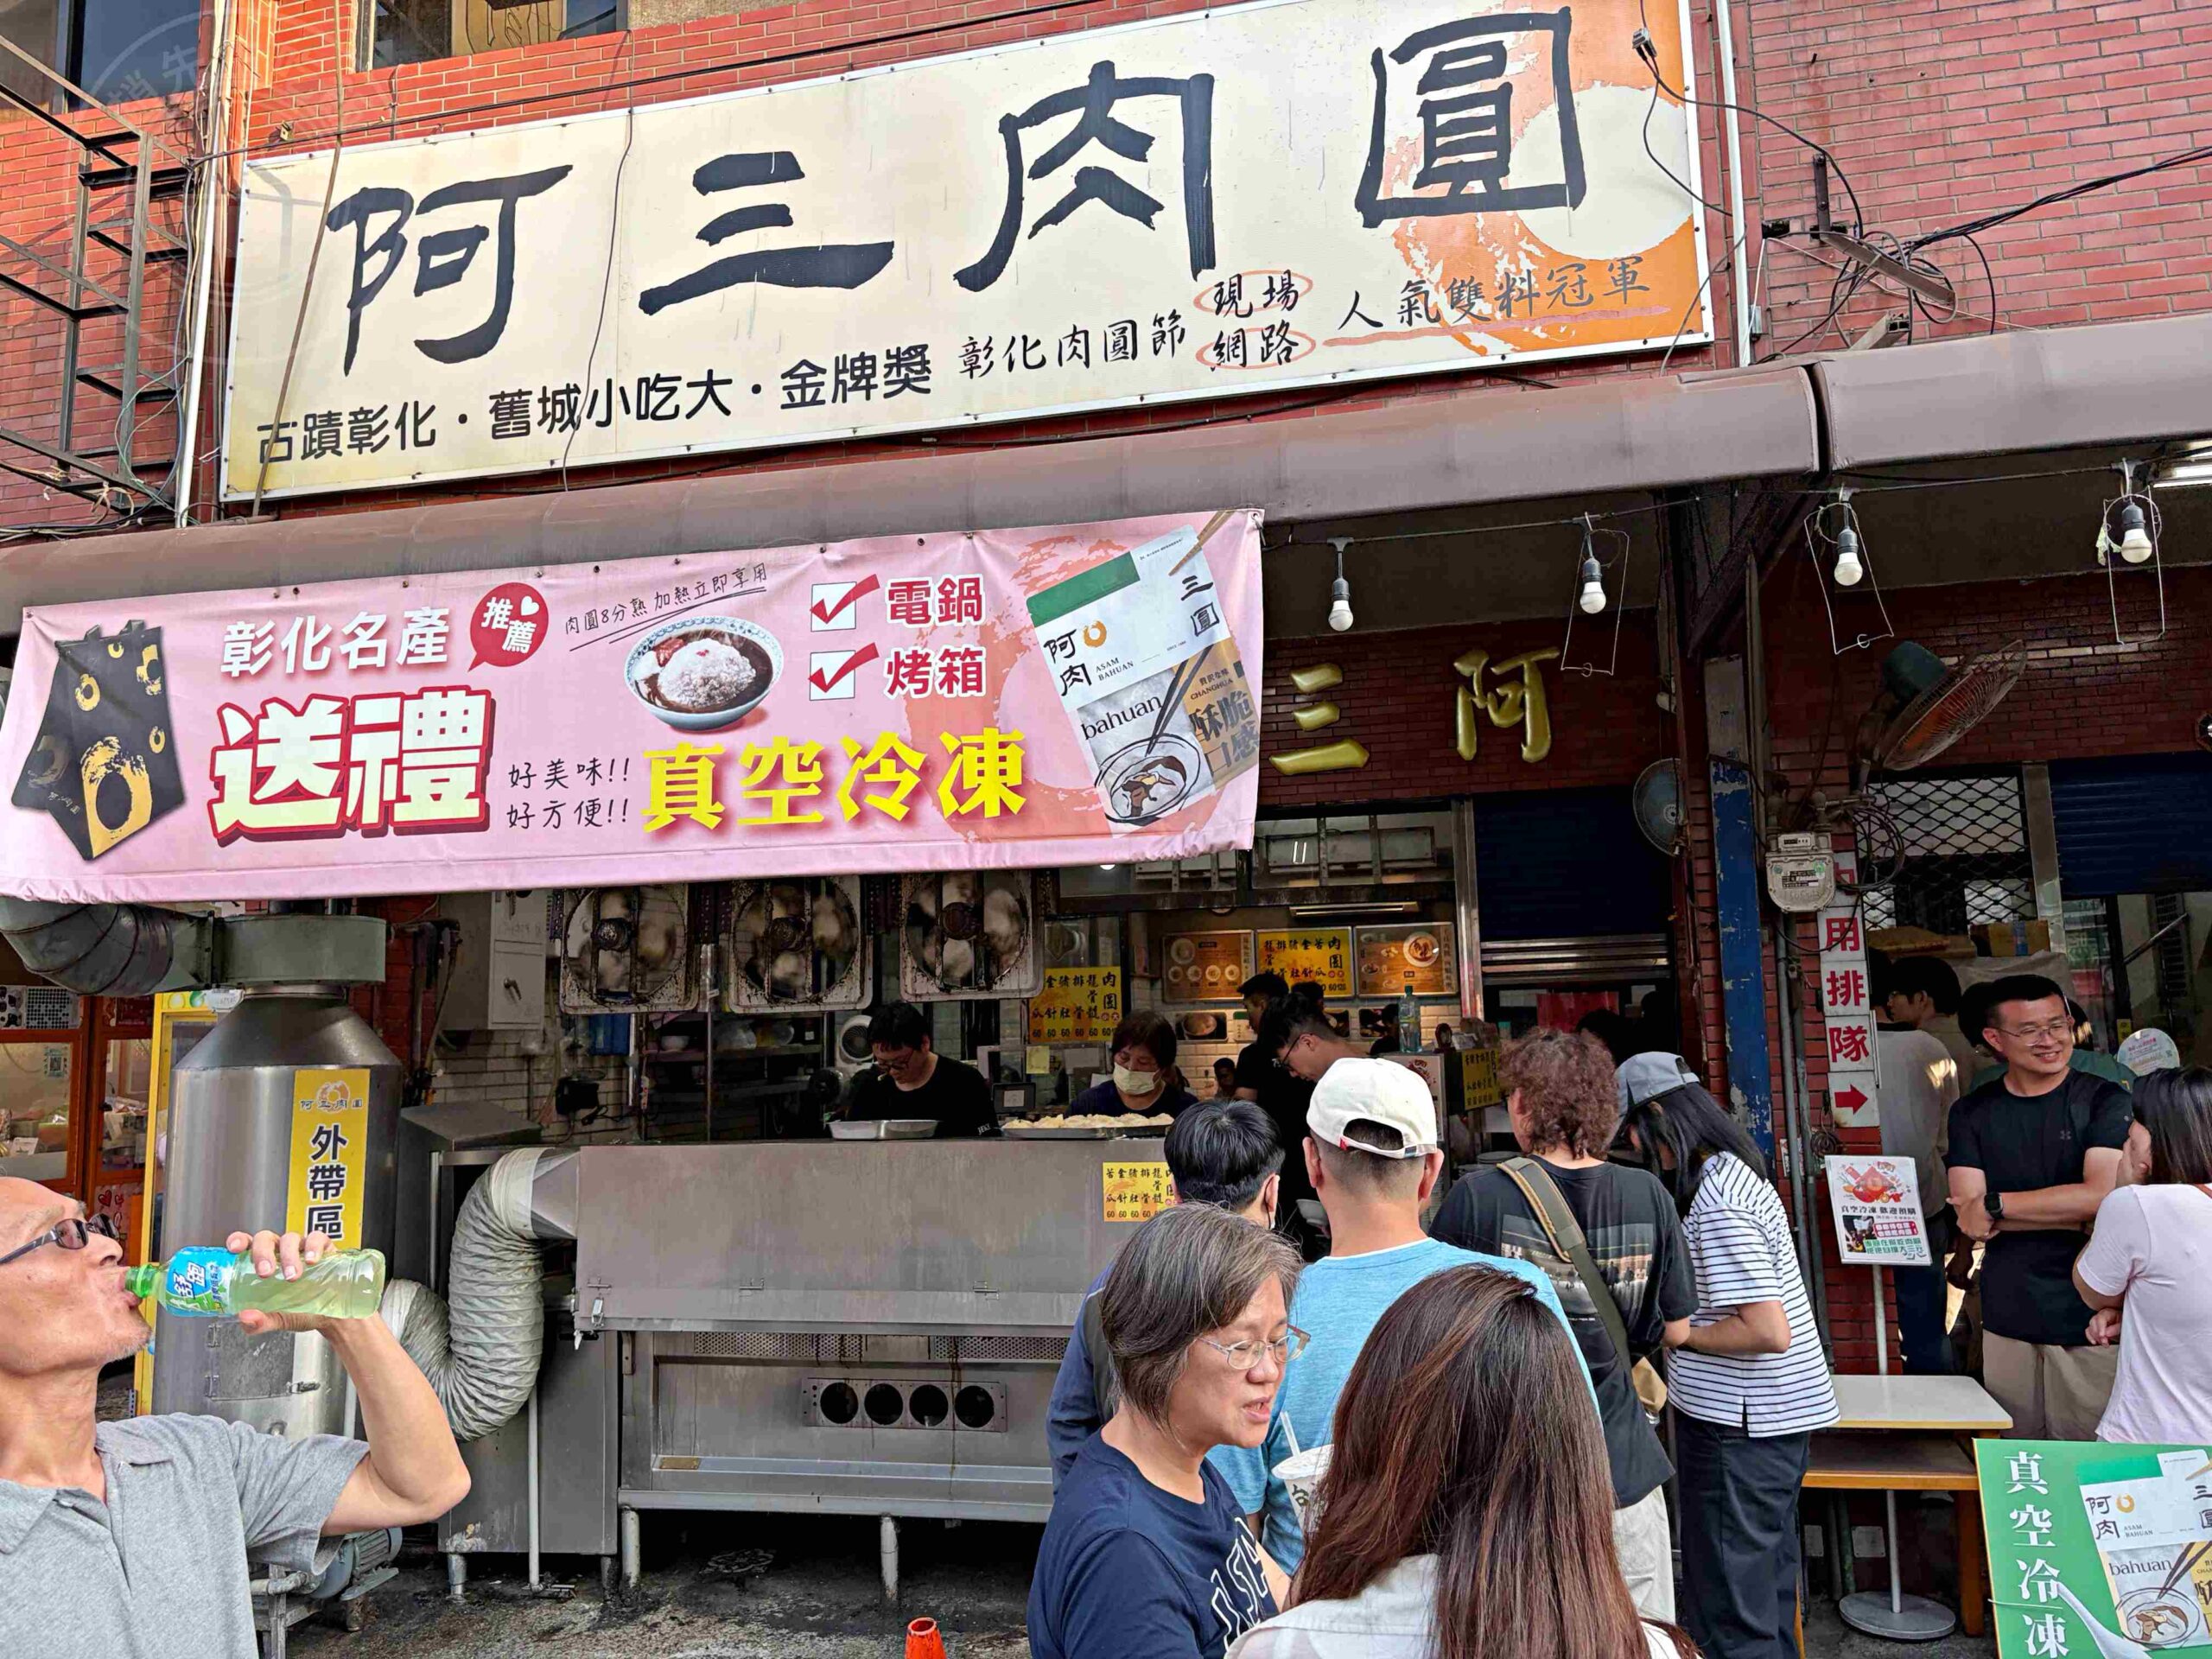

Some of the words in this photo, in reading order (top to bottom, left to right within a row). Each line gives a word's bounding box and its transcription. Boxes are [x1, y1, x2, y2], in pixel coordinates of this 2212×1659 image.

[326, 7, 1586, 377] 阿三肉圓
[1212, 270, 1300, 318] 現場
[1338, 256, 1652, 331] 人氣雙料冠軍
[957, 308, 1186, 379] 彰化肉圓節
[1210, 323, 1300, 372] 網路
[480, 596, 537, 654] 推薦
[886, 575, 983, 626] 電鍋
[221, 606, 451, 677] 彰化名產
[1095, 657, 1120, 673] ASAM
[886, 645, 987, 698] 烤箱
[1098, 660, 1135, 682] BAHUAN
[1190, 677, 1234, 701] CHANGHUA
[1081, 696, 1163, 741] bahuan
[211, 686, 493, 844] 送禮
[641, 727, 1028, 834] 真空冷凍
[307, 1124, 348, 1239] 外帶區
[1107, 1210, 1116, 1218] 60
[1119, 1210, 1128, 1218] 60
[1130, 1210, 1140, 1218] 60
[1142, 1210, 1151, 1218] 60
[174, 1261, 207, 1300] 舒跑
[2004, 1451, 2070, 1659] 真空冷凍
[2109, 1560, 2173, 1577] bahuan
